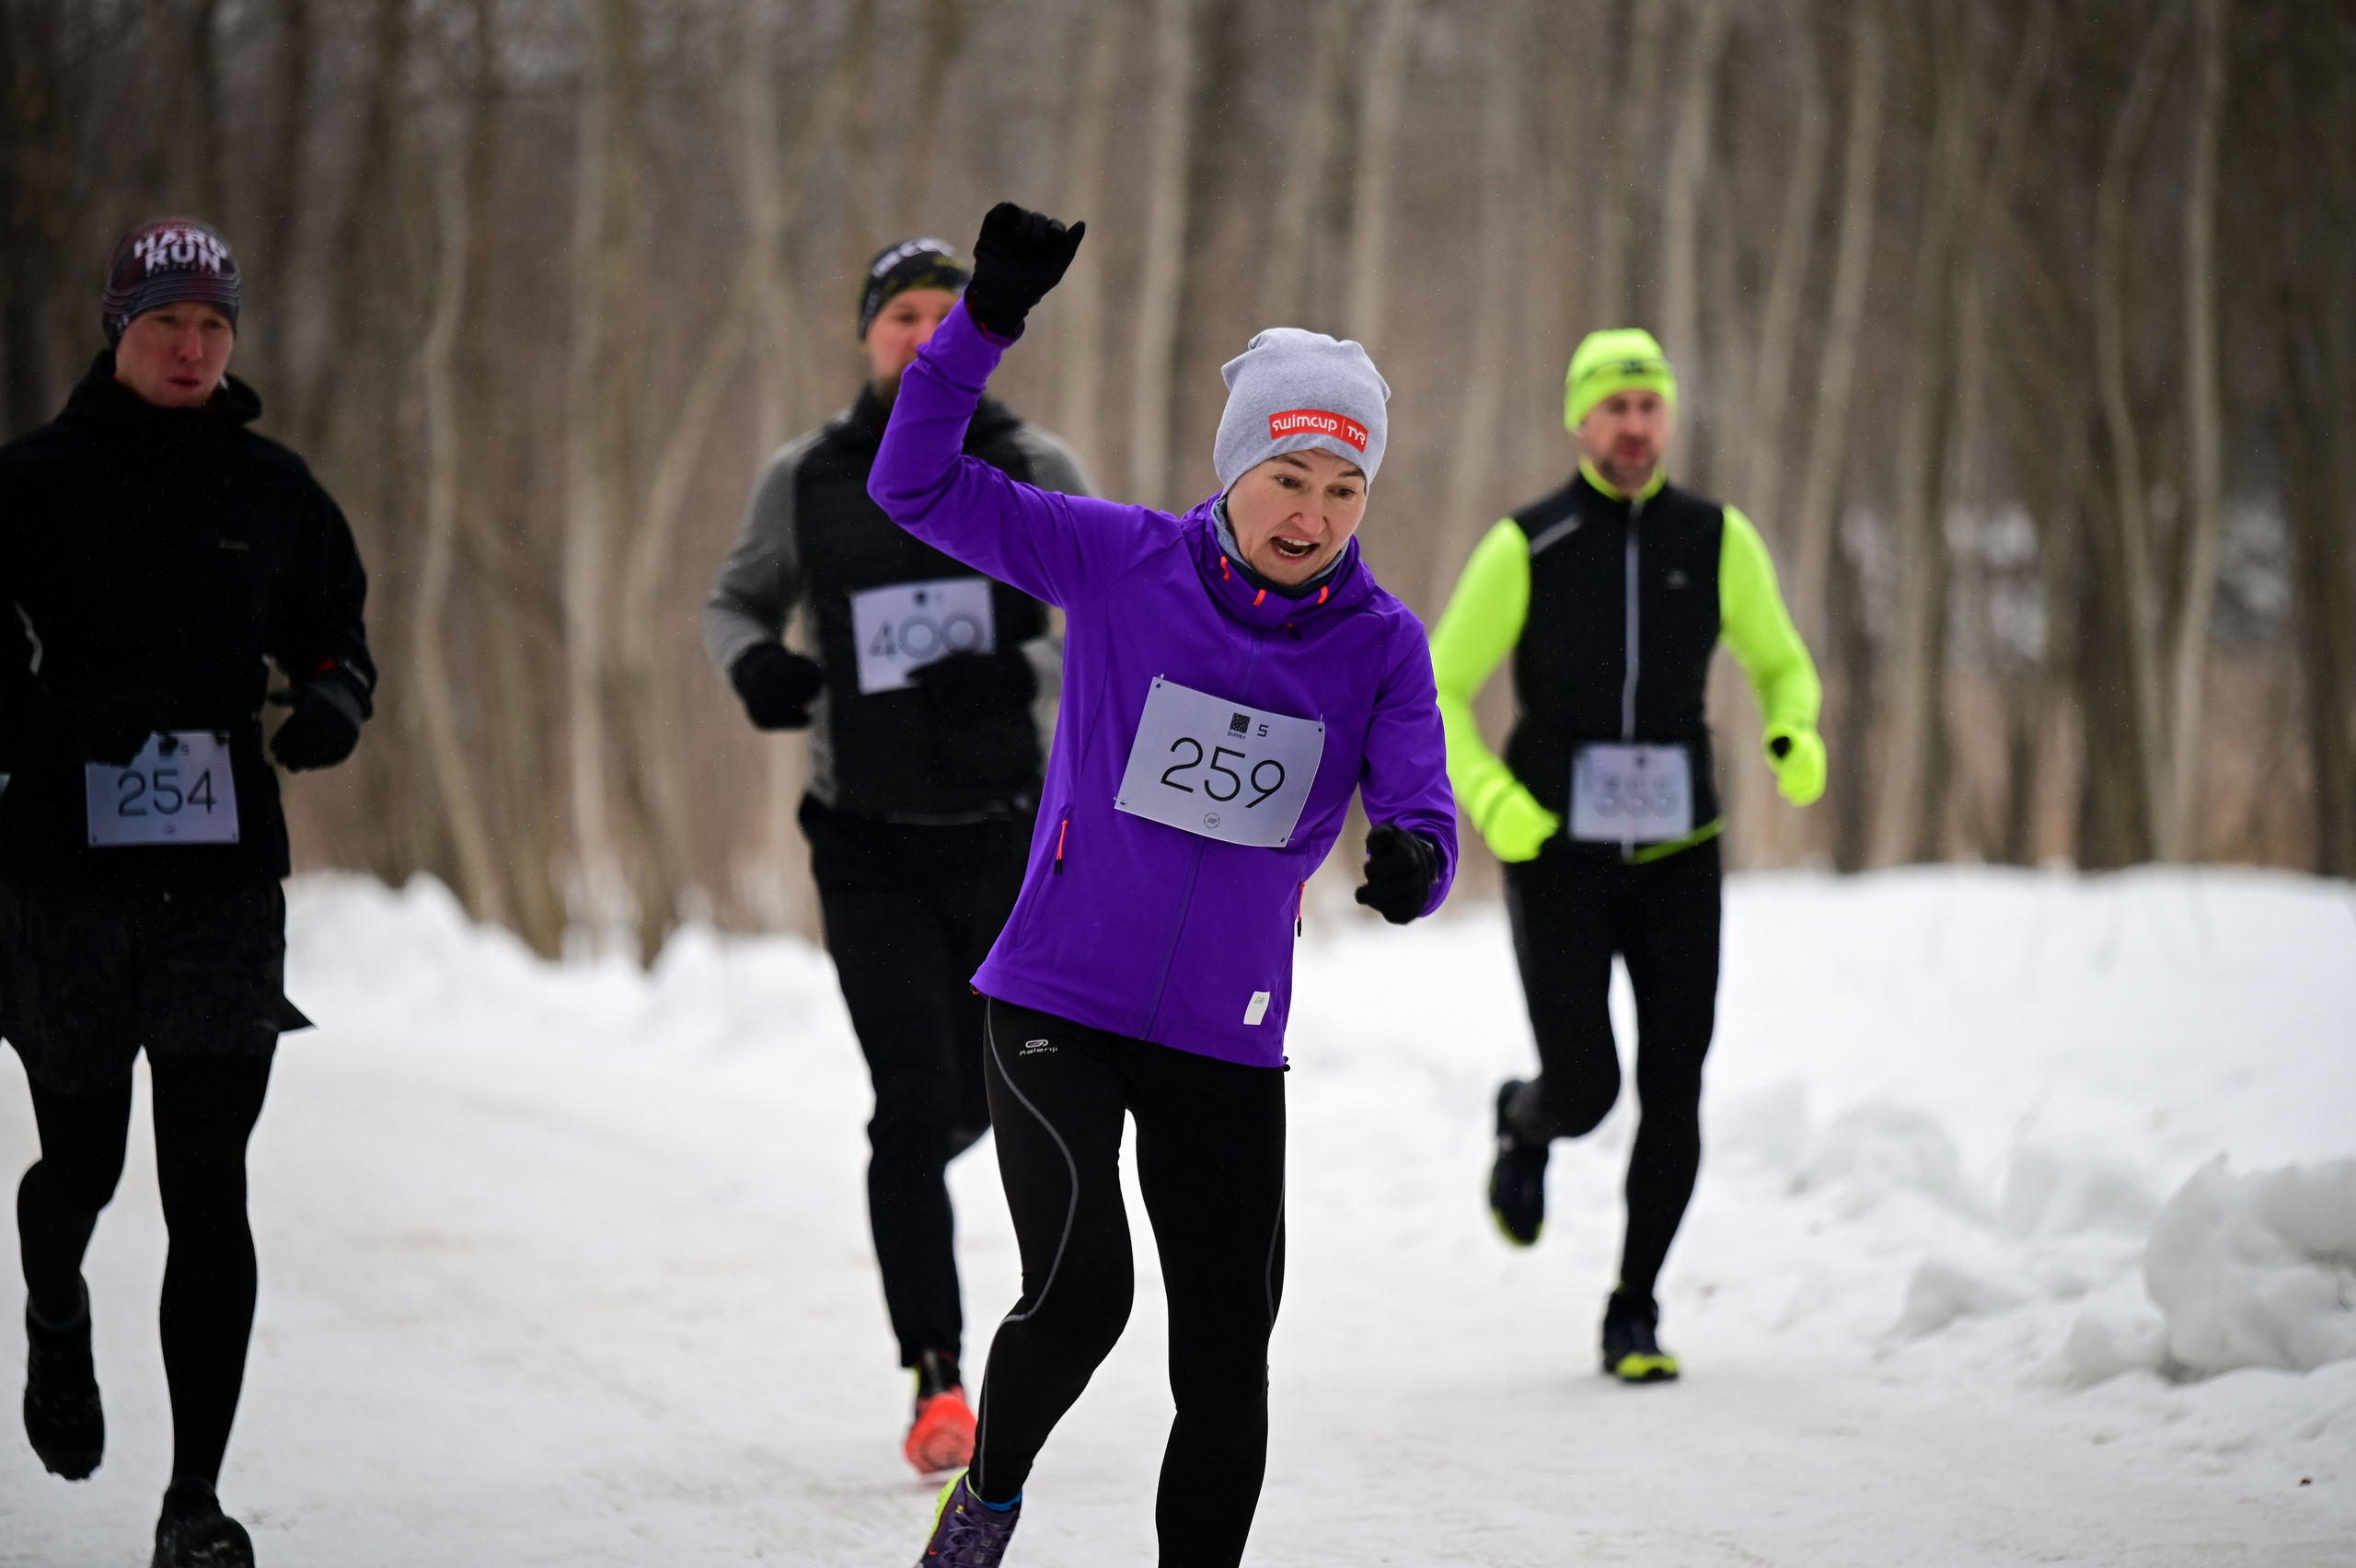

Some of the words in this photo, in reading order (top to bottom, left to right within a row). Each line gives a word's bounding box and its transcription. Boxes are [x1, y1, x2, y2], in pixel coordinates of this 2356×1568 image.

[144, 244, 221, 275] RUN
[1272, 415, 1337, 432] swimcup
[1347, 425, 1367, 445] TYR
[869, 611, 986, 663] 400
[118, 768, 216, 816] 254
[1161, 737, 1285, 808] 259
